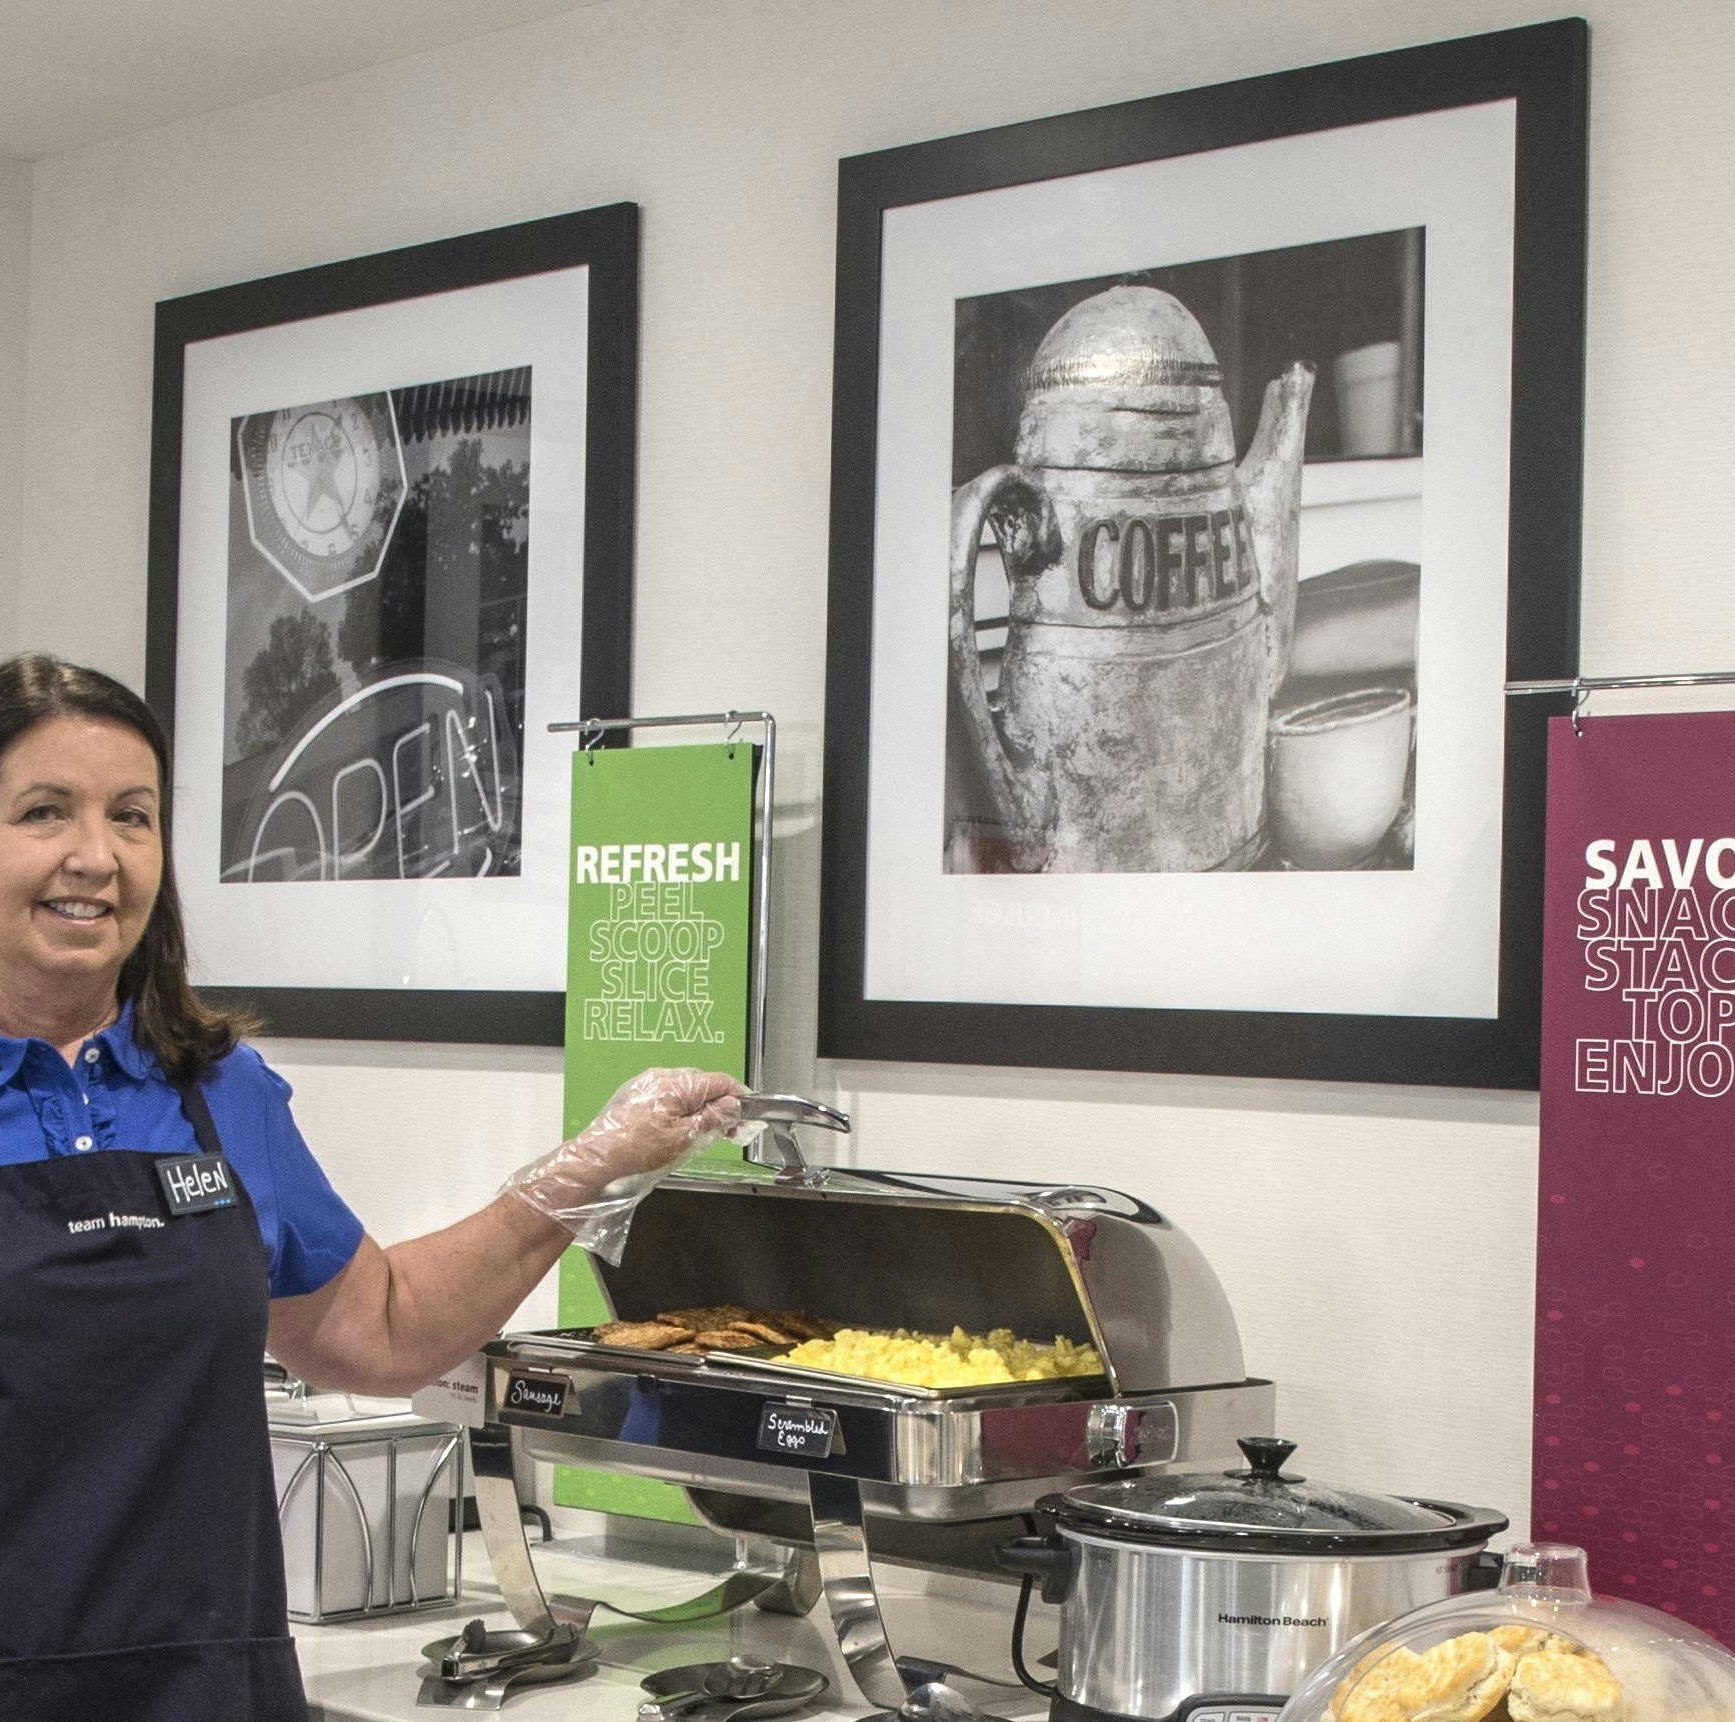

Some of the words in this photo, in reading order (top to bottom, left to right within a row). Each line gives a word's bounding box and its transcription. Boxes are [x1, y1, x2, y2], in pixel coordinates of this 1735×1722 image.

[248, 689, 502, 883] OPEN
[576, 842, 740, 884] REFRESH
[609, 880, 704, 922] PEEL
[589, 919, 725, 962] SCOOP
[601, 958, 710, 1002] SLICE
[583, 998, 725, 1043] RELAX.
[68, 1216, 105, 1234] team
[453, 1381, 479, 1394] steam
[511, 1379, 562, 1413] Sausage
[767, 1412, 829, 1435] Scrambled
[1218, 1612, 1281, 1626] Hamilton
[1282, 1616, 1327, 1627] Beach
